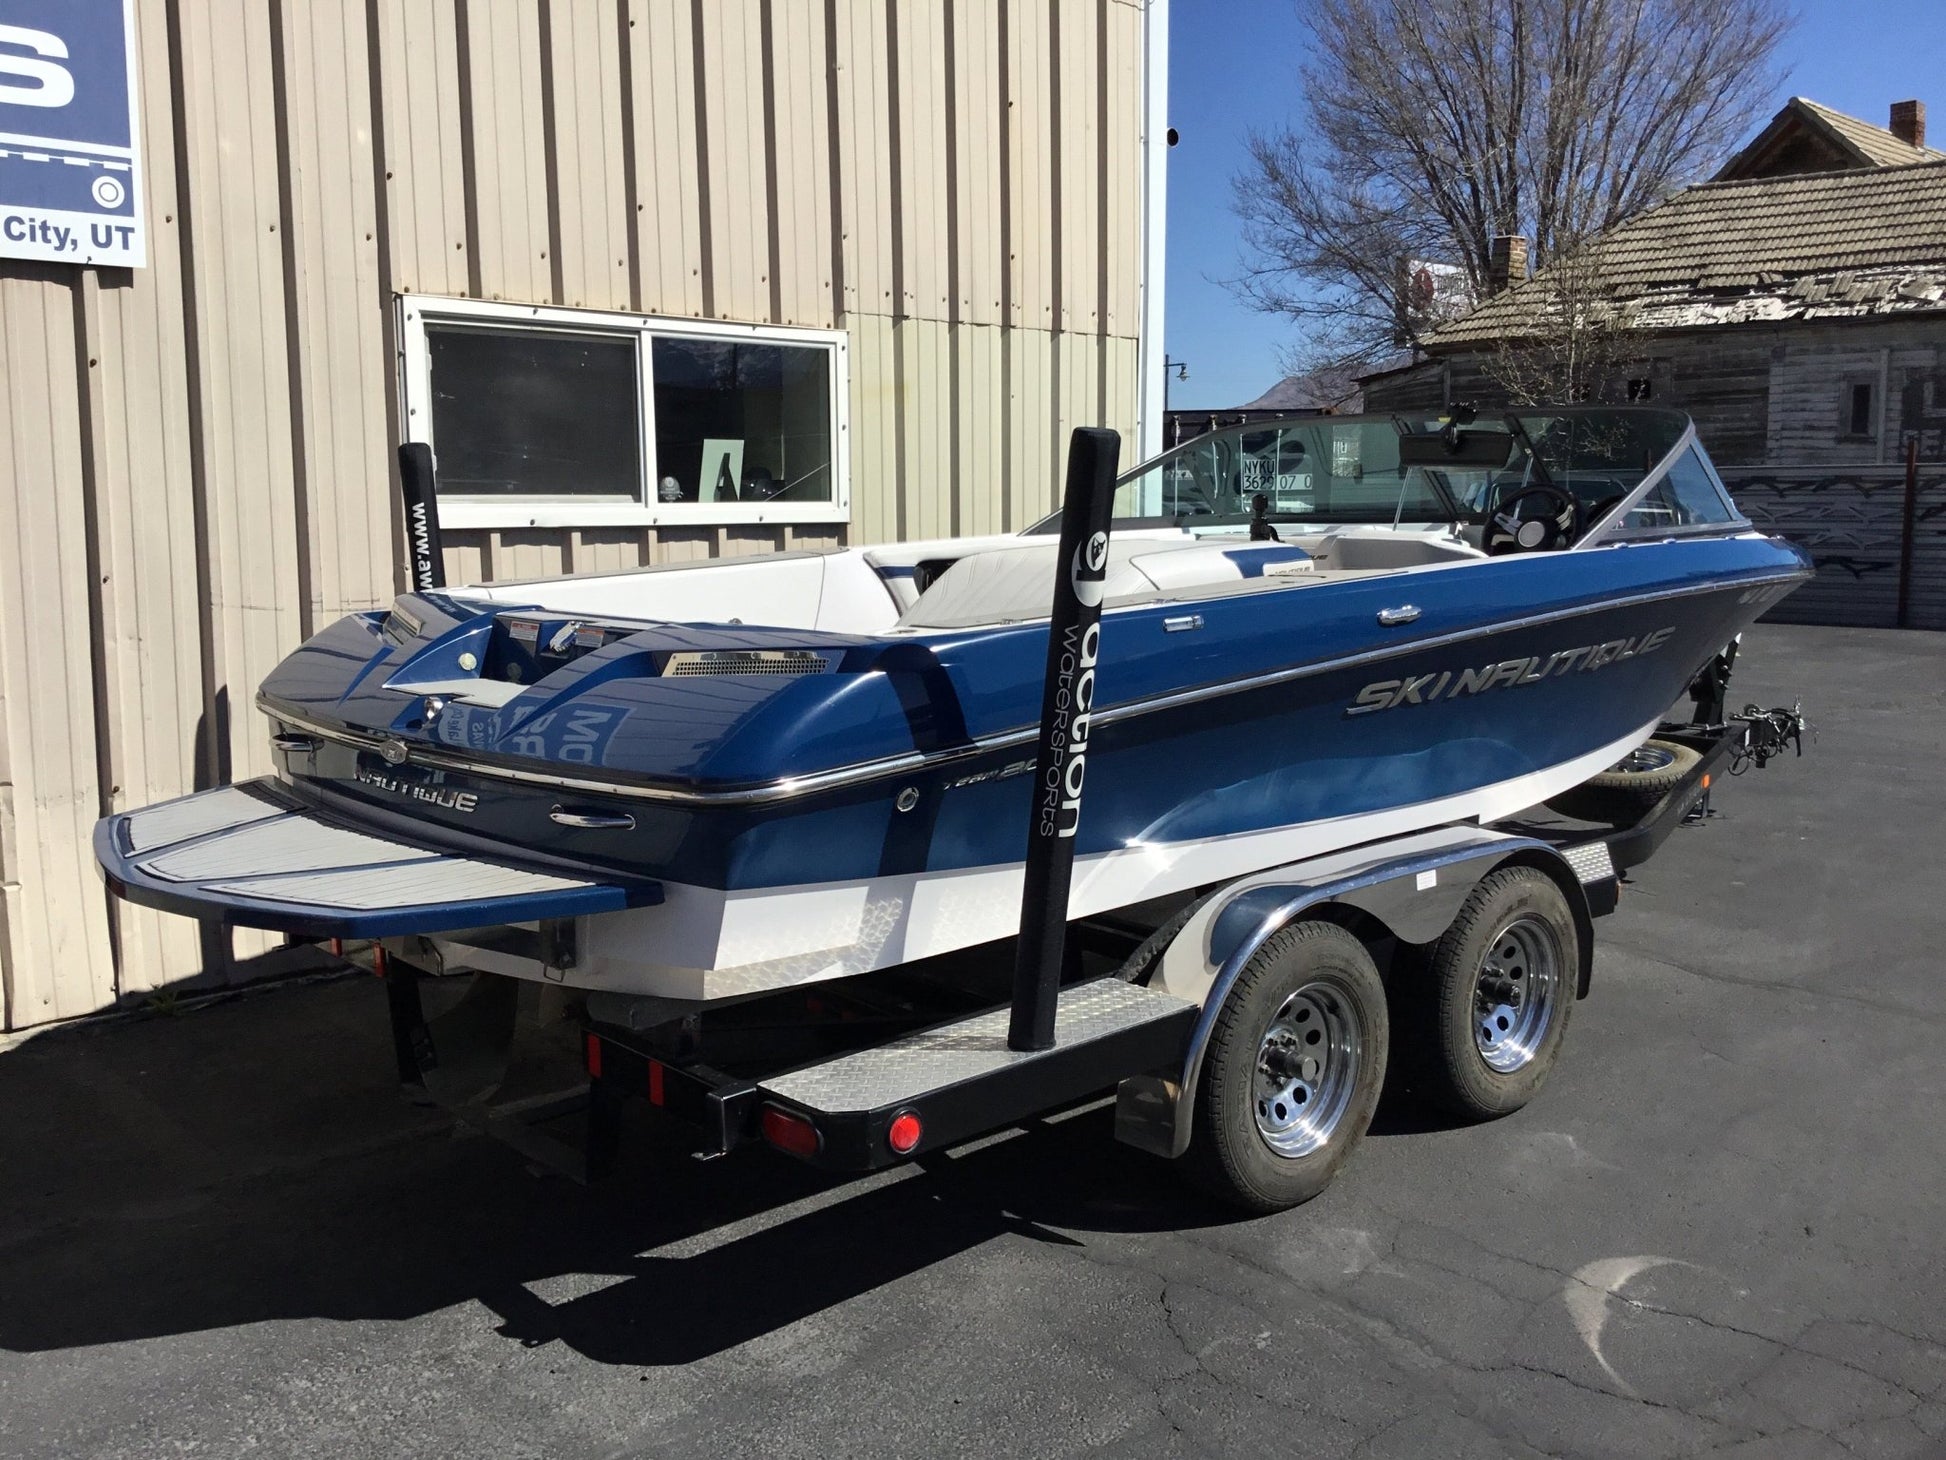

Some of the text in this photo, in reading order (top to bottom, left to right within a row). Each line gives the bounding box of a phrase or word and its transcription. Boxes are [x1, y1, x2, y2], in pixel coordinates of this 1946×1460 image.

[3, 215, 135, 252] City, UT
[1244, 460, 1275, 474] NYKU
[1244, 475, 1275, 489] 3629
[1280, 475, 1296, 489] 07
[1346, 626, 1676, 714] SKI NAUTIQUE
[1058, 621, 1100, 838] action
